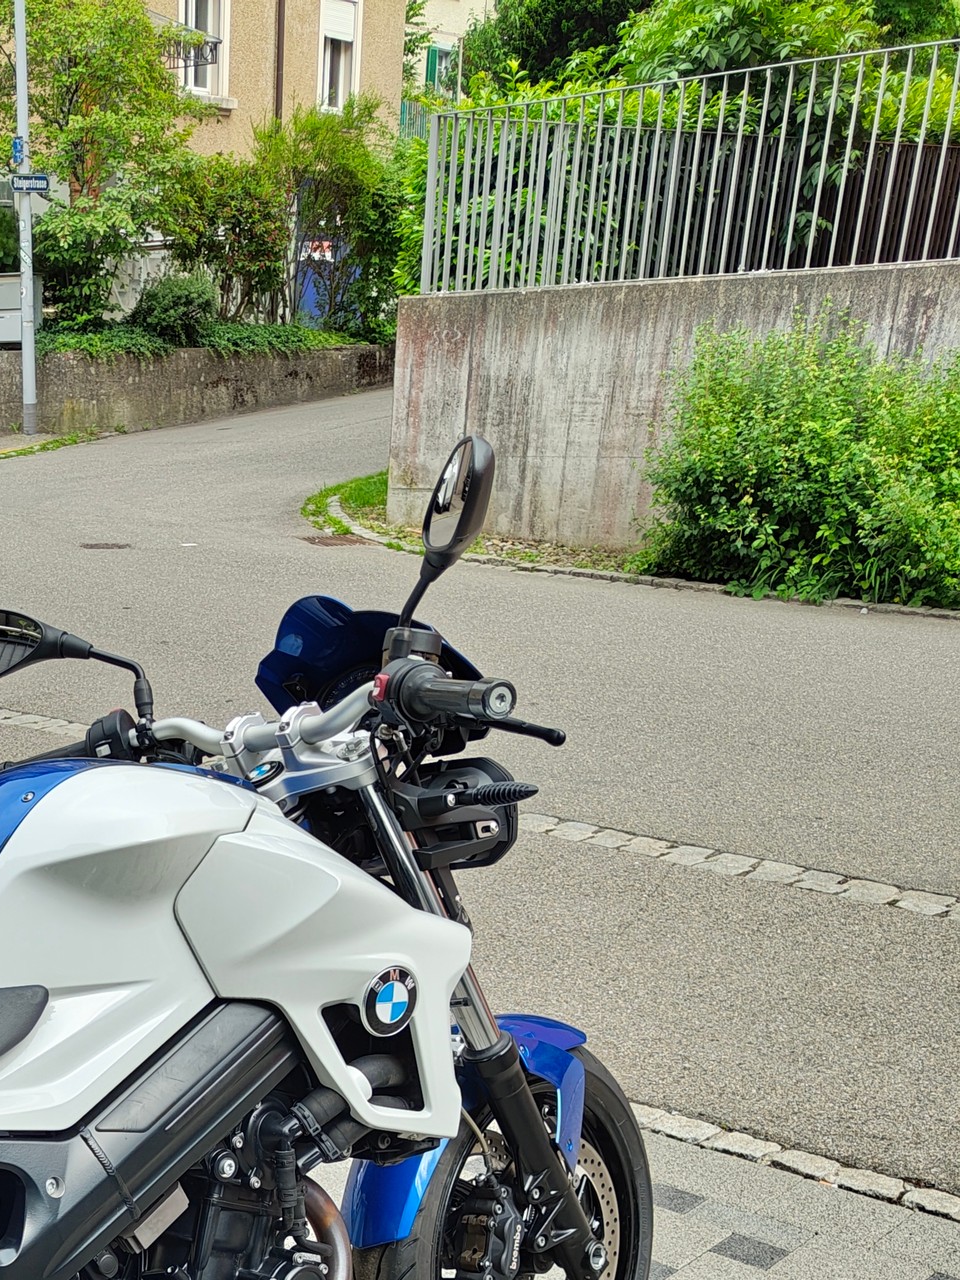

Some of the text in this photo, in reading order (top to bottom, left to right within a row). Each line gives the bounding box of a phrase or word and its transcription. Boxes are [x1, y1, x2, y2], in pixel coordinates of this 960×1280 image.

[13, 177, 47, 190] Steigerstrasse
[372, 969, 415, 993] BMW
[510, 1224, 522, 1270] brembo
